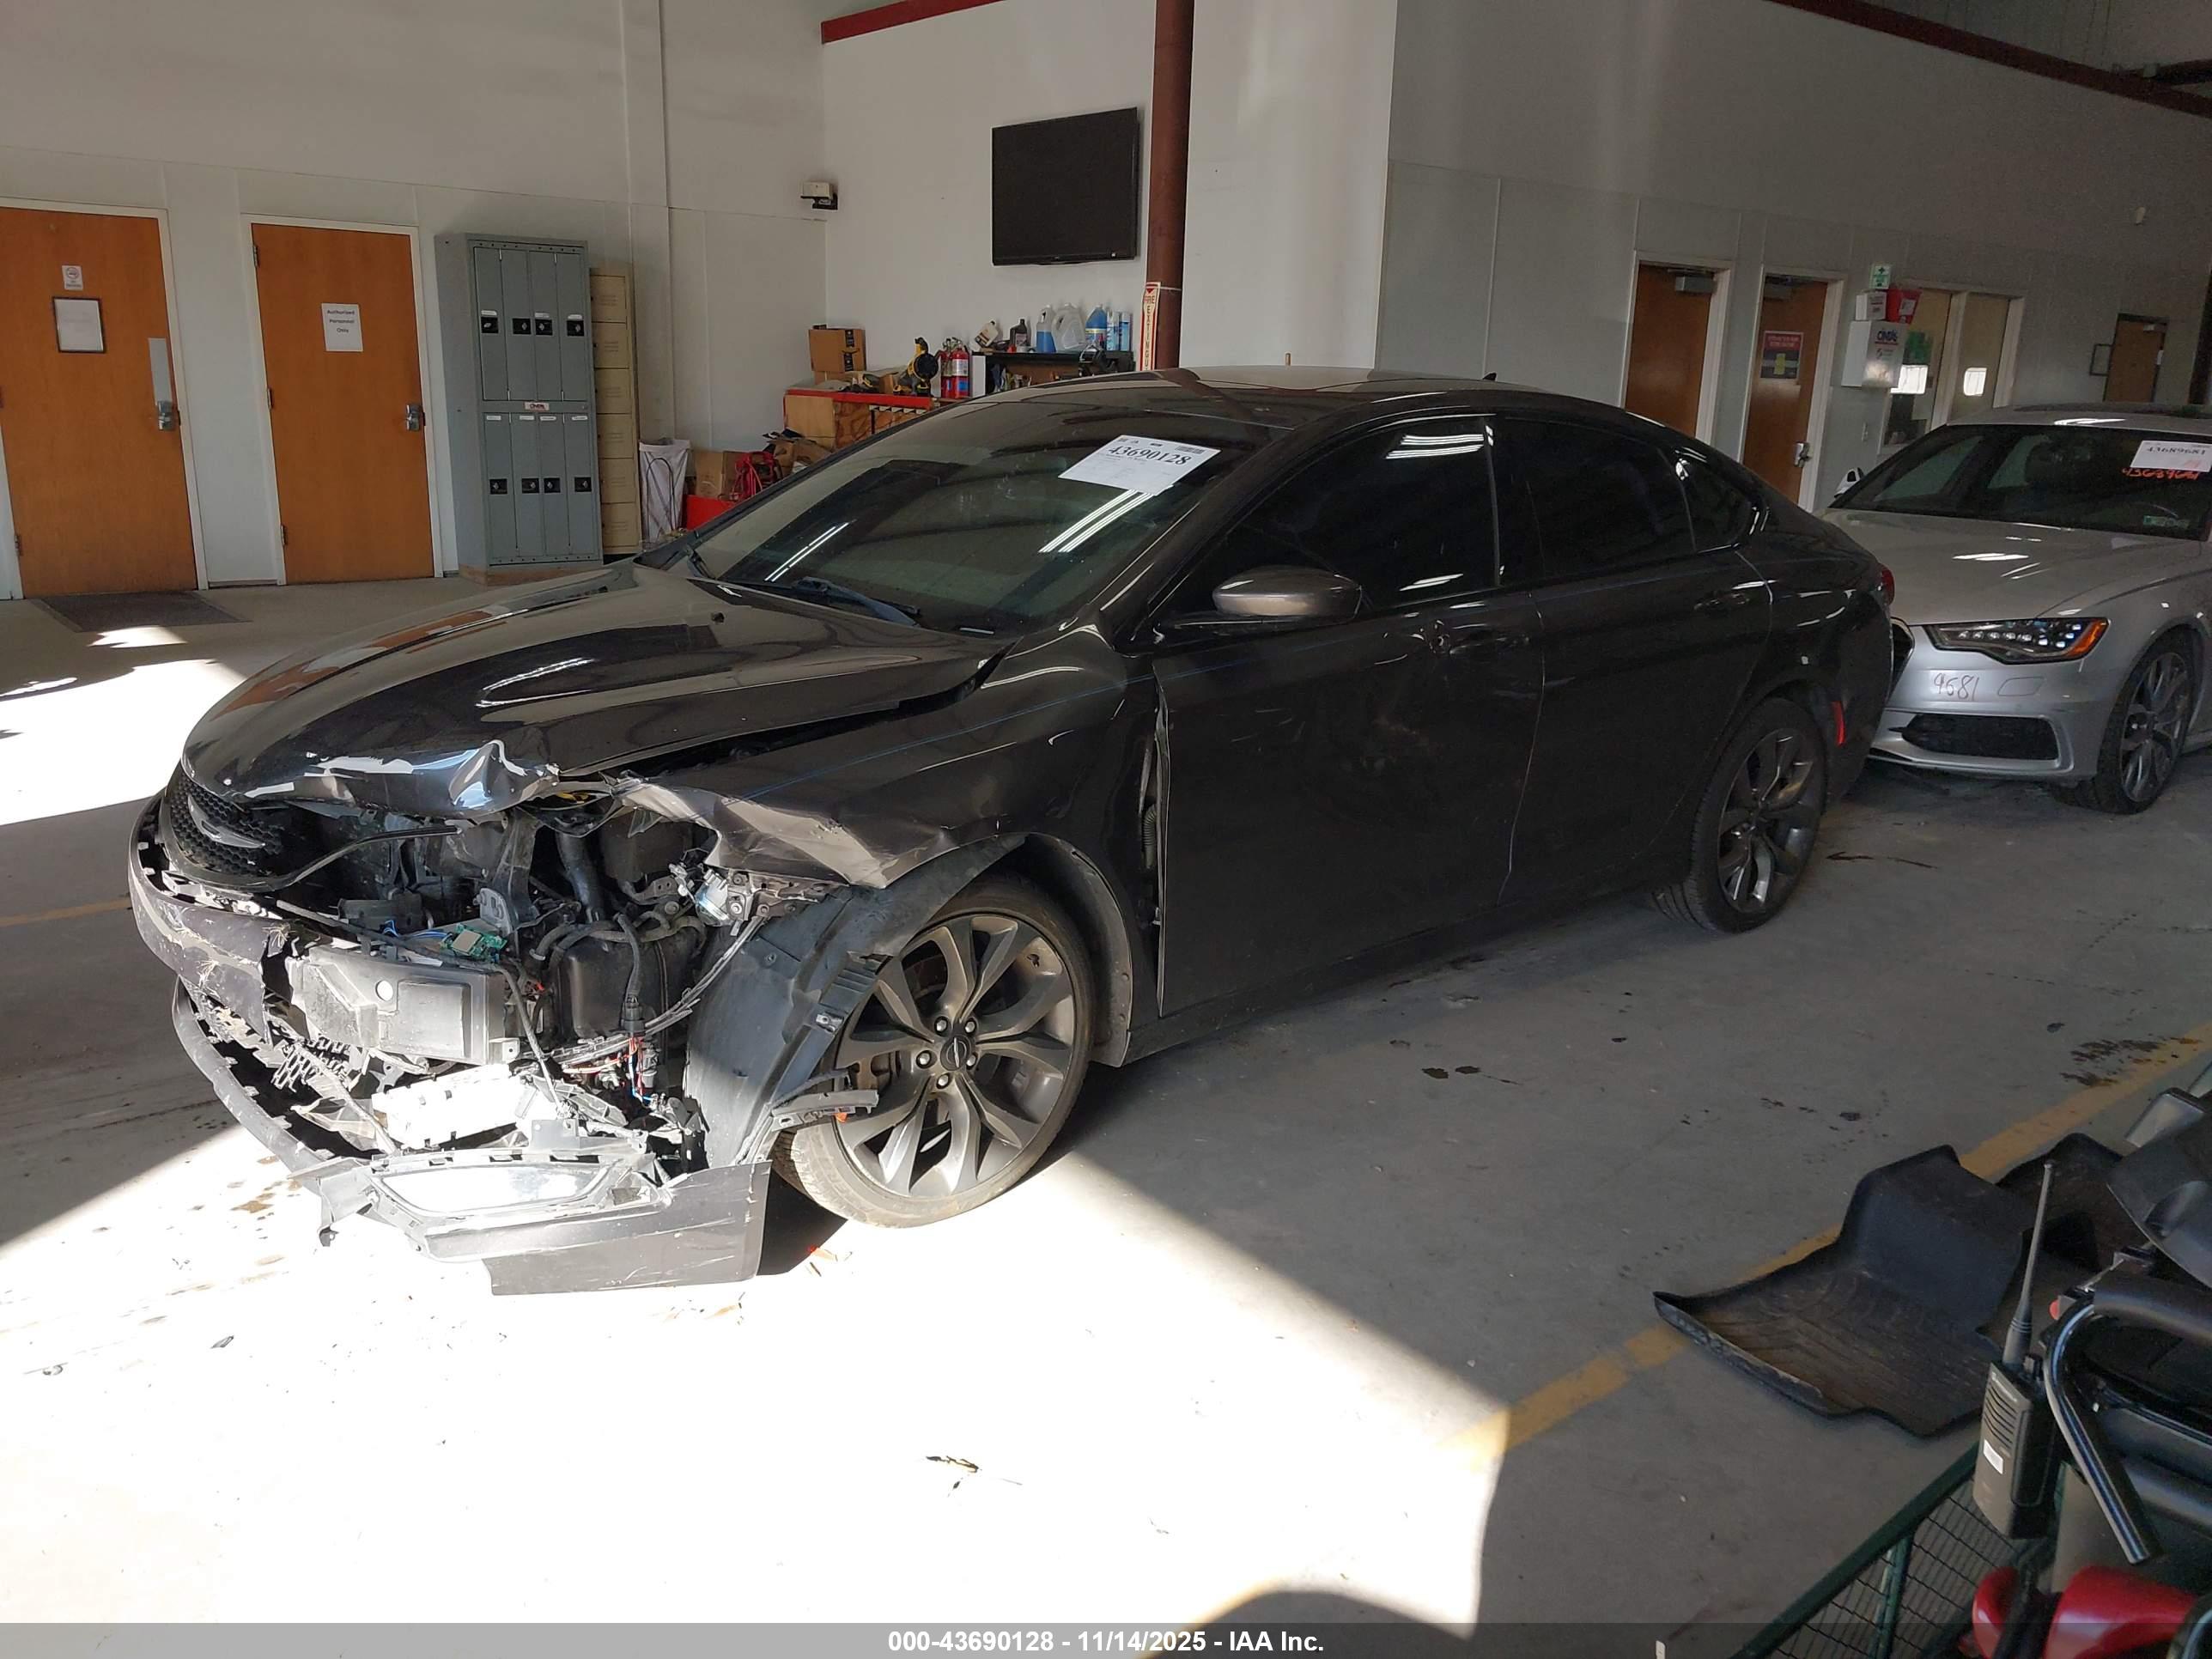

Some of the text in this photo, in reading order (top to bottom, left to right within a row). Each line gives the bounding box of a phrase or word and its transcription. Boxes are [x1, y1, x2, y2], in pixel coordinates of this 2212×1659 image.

[1144, 305, 1152, 370] EXTINGU
[1109, 445, 1192, 465] 43690128
[1934, 672, 1980, 702] 9681
